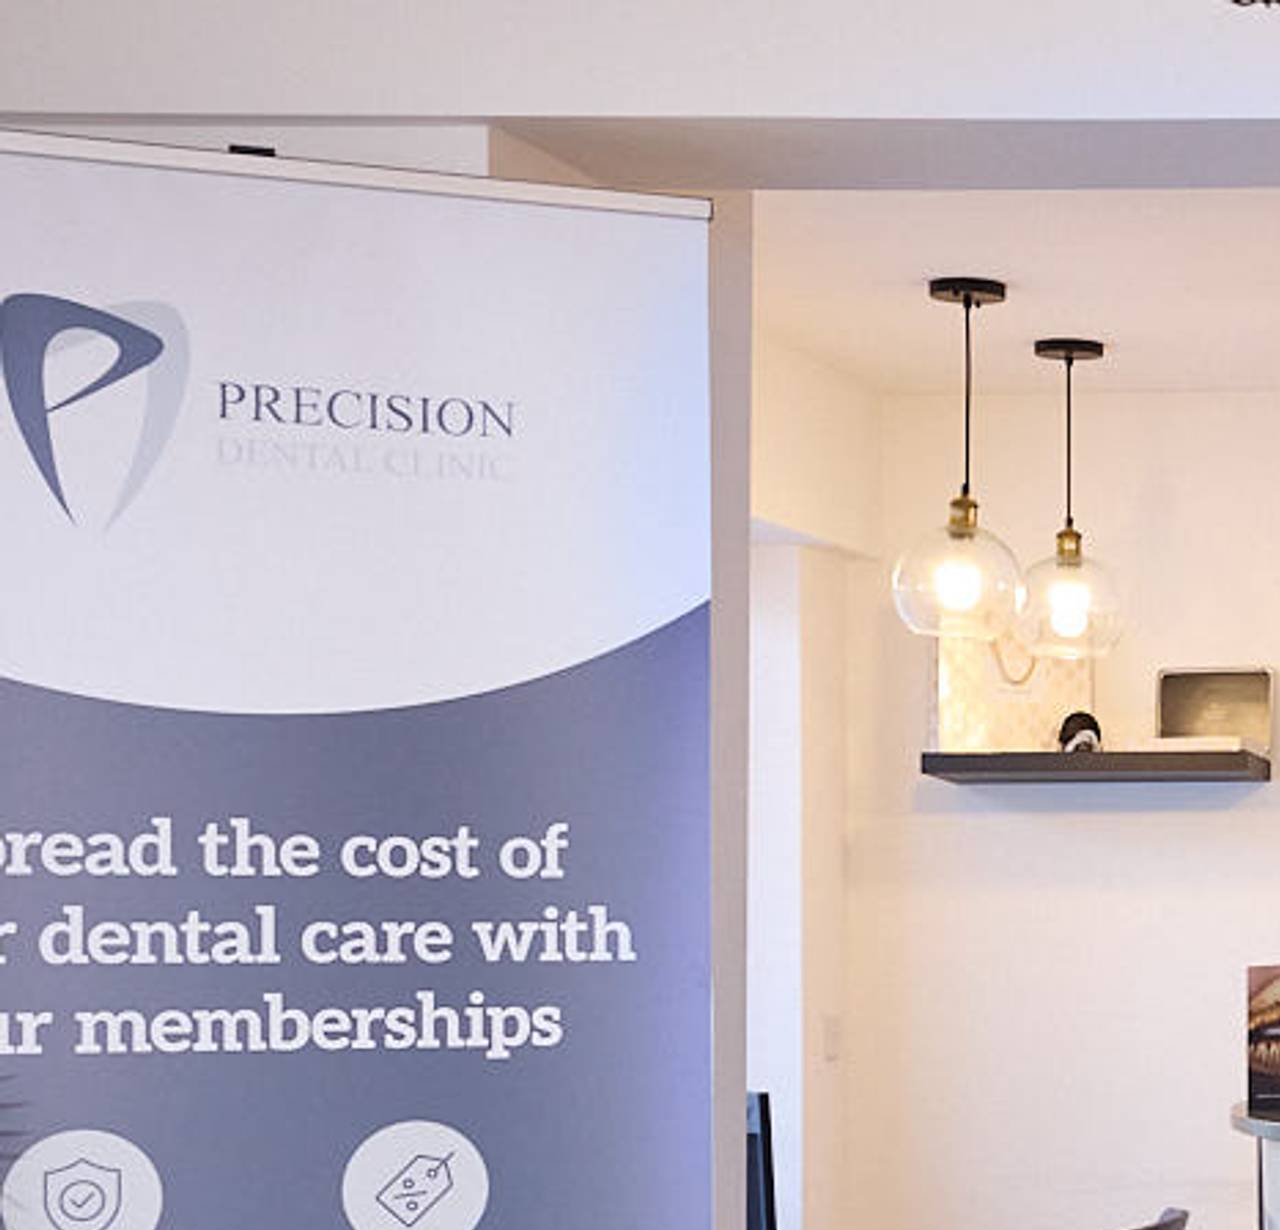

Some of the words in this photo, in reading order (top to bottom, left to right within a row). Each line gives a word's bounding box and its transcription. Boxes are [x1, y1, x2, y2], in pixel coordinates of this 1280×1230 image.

[218, 382, 515, 438] PRECISION
[217, 438, 373, 474] DENTAL
[382, 446, 508, 481] CLINIC
[0, 817, 177, 876] read
[198, 817, 320, 877] the
[340, 825, 480, 879] cost
[499, 823, 569, 879] of
[38, 905, 282, 964] dental
[301, 921, 453, 964] care
[472, 905, 637, 962] with
[74, 991, 563, 1060] memberships
